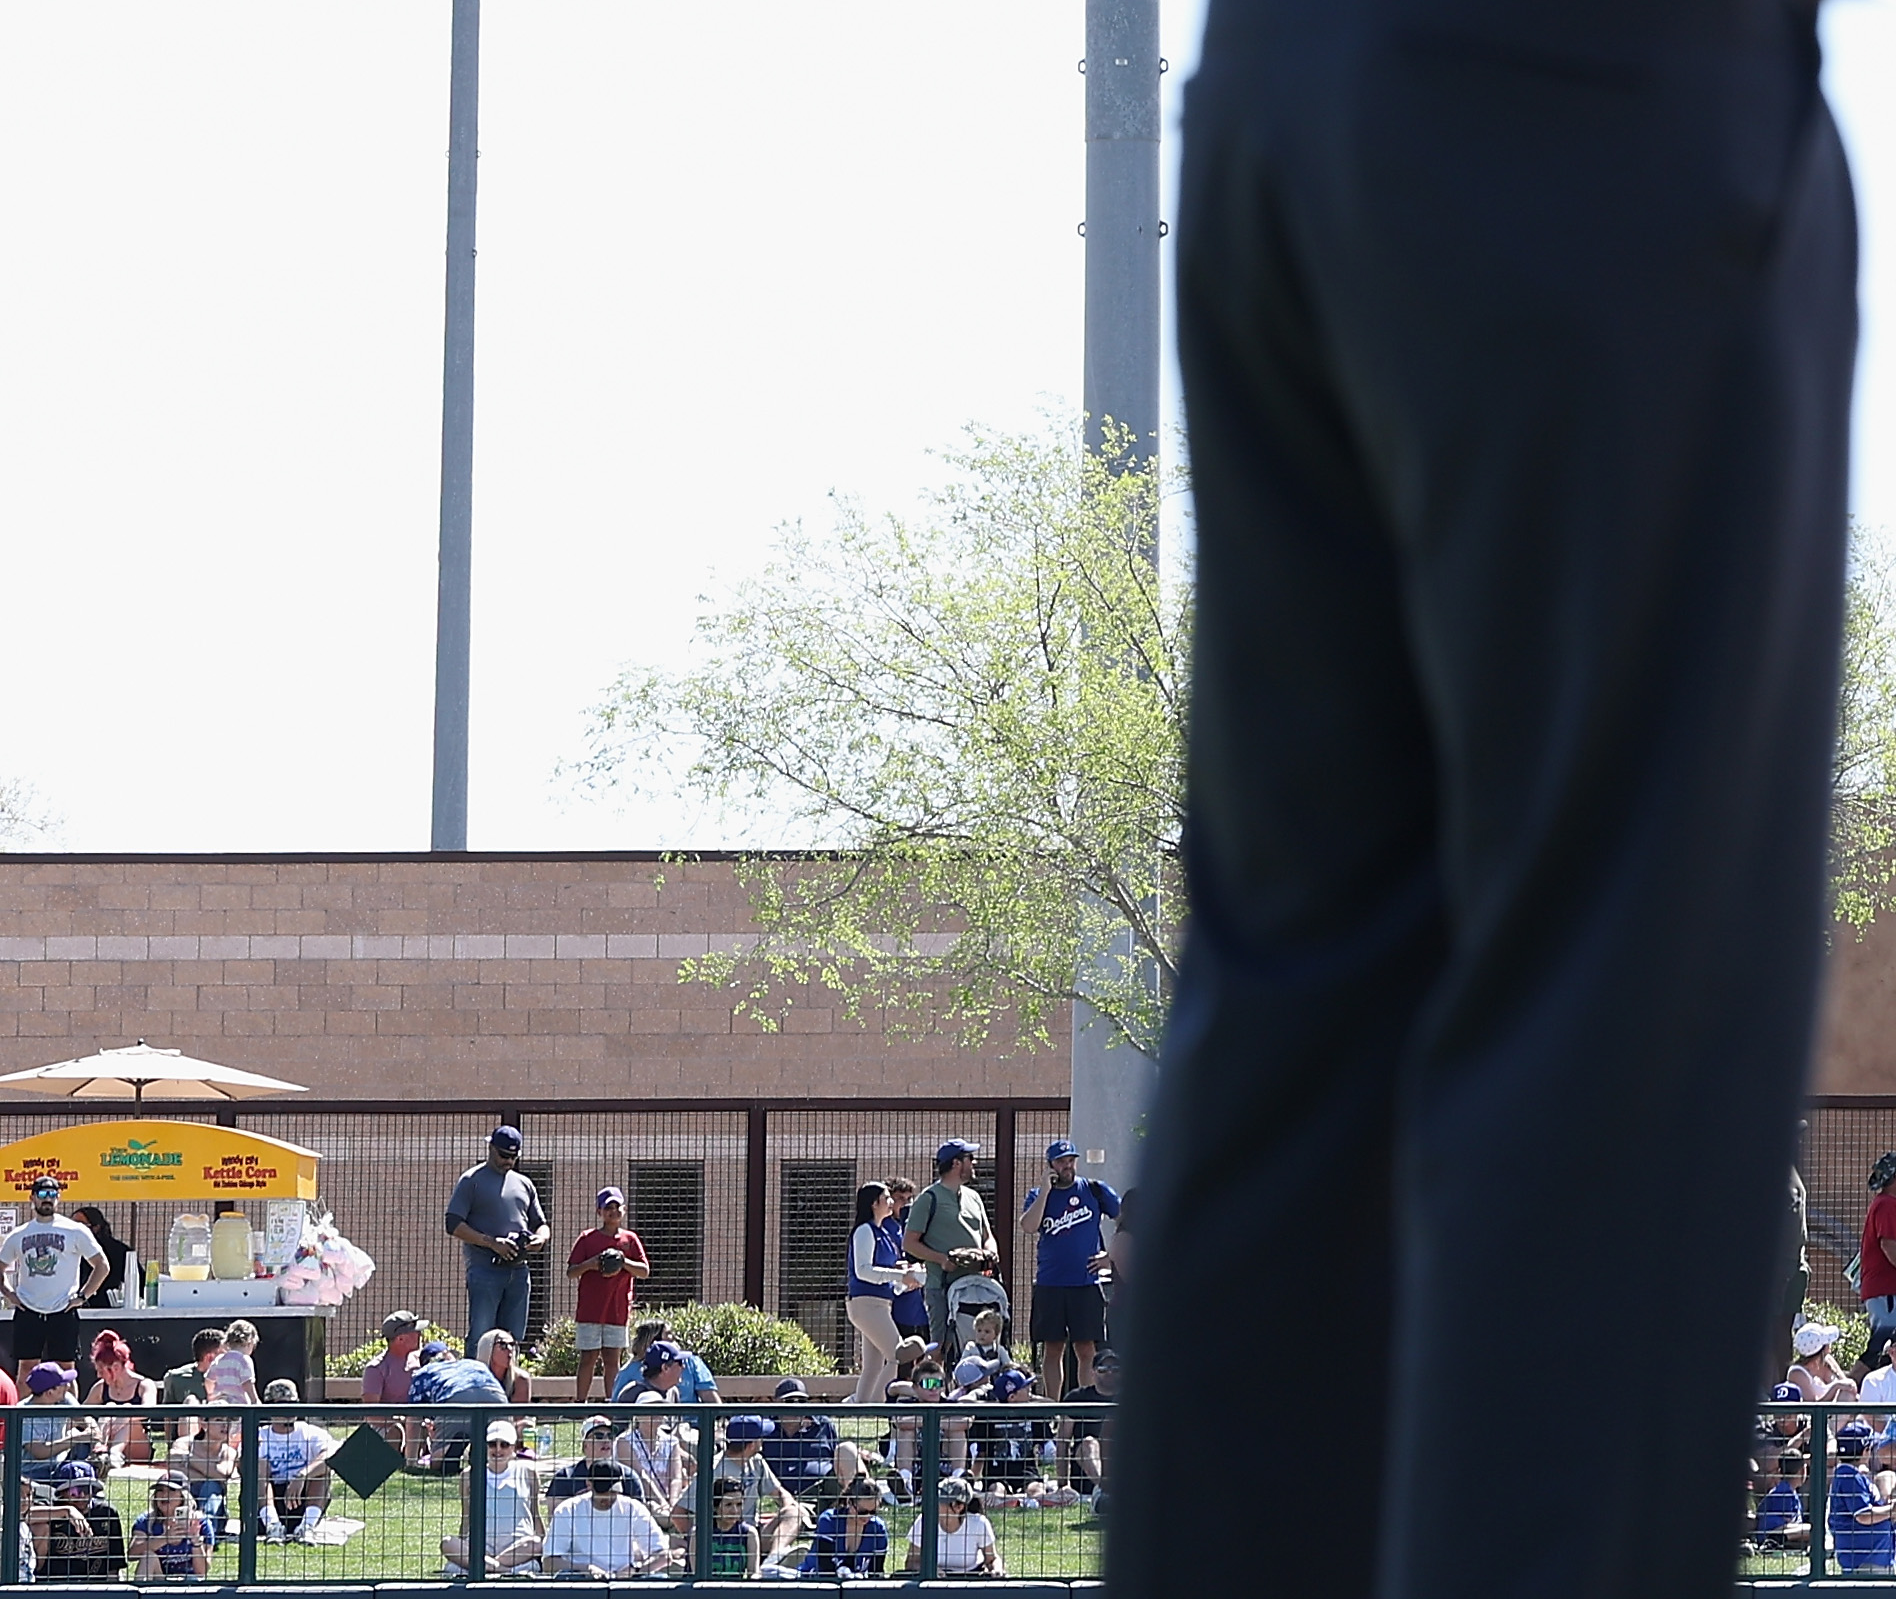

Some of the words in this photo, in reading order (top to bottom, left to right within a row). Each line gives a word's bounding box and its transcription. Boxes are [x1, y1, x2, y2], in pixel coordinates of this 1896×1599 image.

[101, 1152, 182, 1166] LEMONADE
[4, 1169, 43, 1181] Kettle
[203, 1166, 242, 1179] Kettle
[245, 1166, 277, 1179] Corn
[1043, 1205, 1093, 1235] Dodgers
